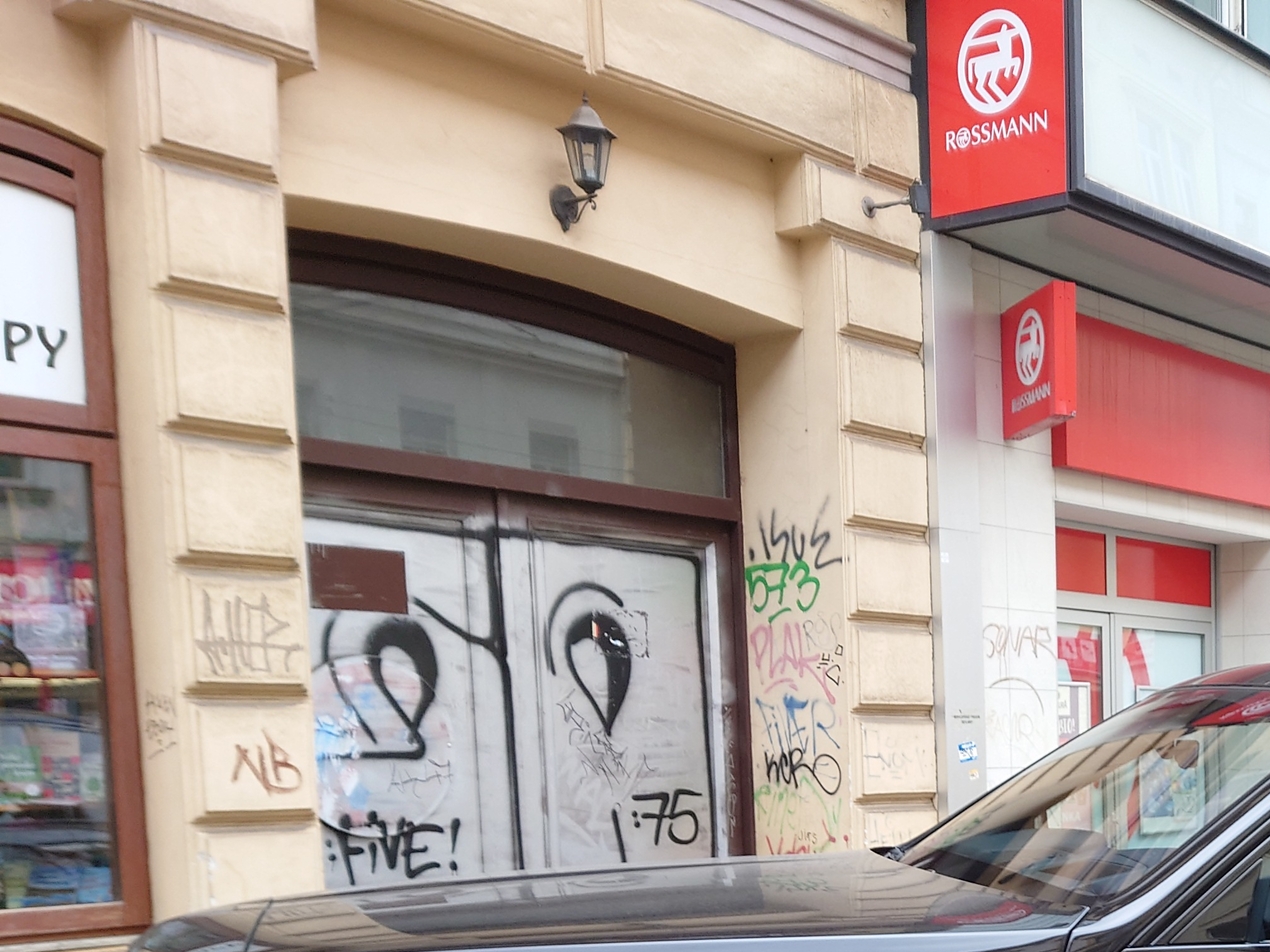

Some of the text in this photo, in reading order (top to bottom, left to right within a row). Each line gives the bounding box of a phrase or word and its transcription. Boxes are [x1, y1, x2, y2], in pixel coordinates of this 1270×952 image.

[945, 109, 1048, 152] ROSSMANN
[3, 318, 67, 369] PY
[744, 560, 820, 614] 573
